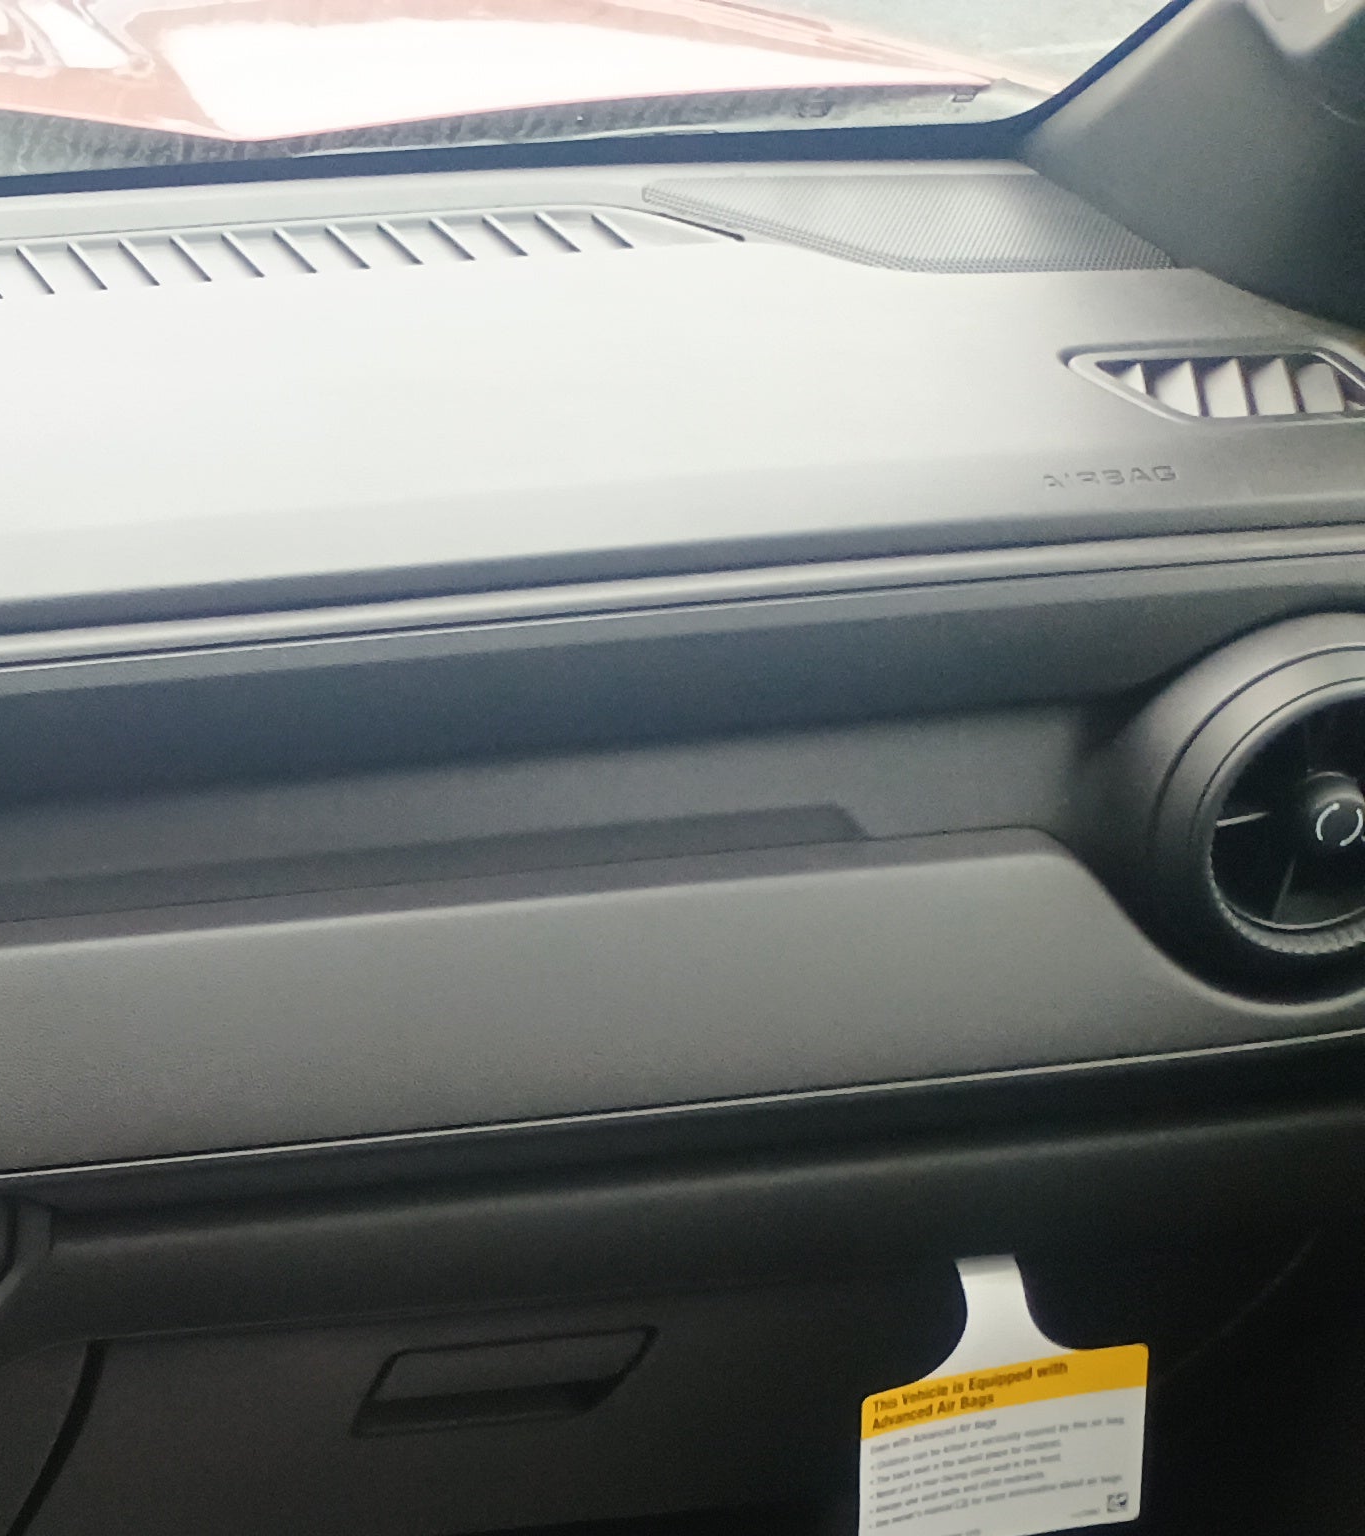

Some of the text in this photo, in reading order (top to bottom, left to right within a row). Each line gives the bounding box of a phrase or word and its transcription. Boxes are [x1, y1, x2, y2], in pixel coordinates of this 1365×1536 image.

[873, 1361, 1068, 1413] This Vehicle is Equipped with
[872, 1392, 995, 1431] Advanced Air Bags
